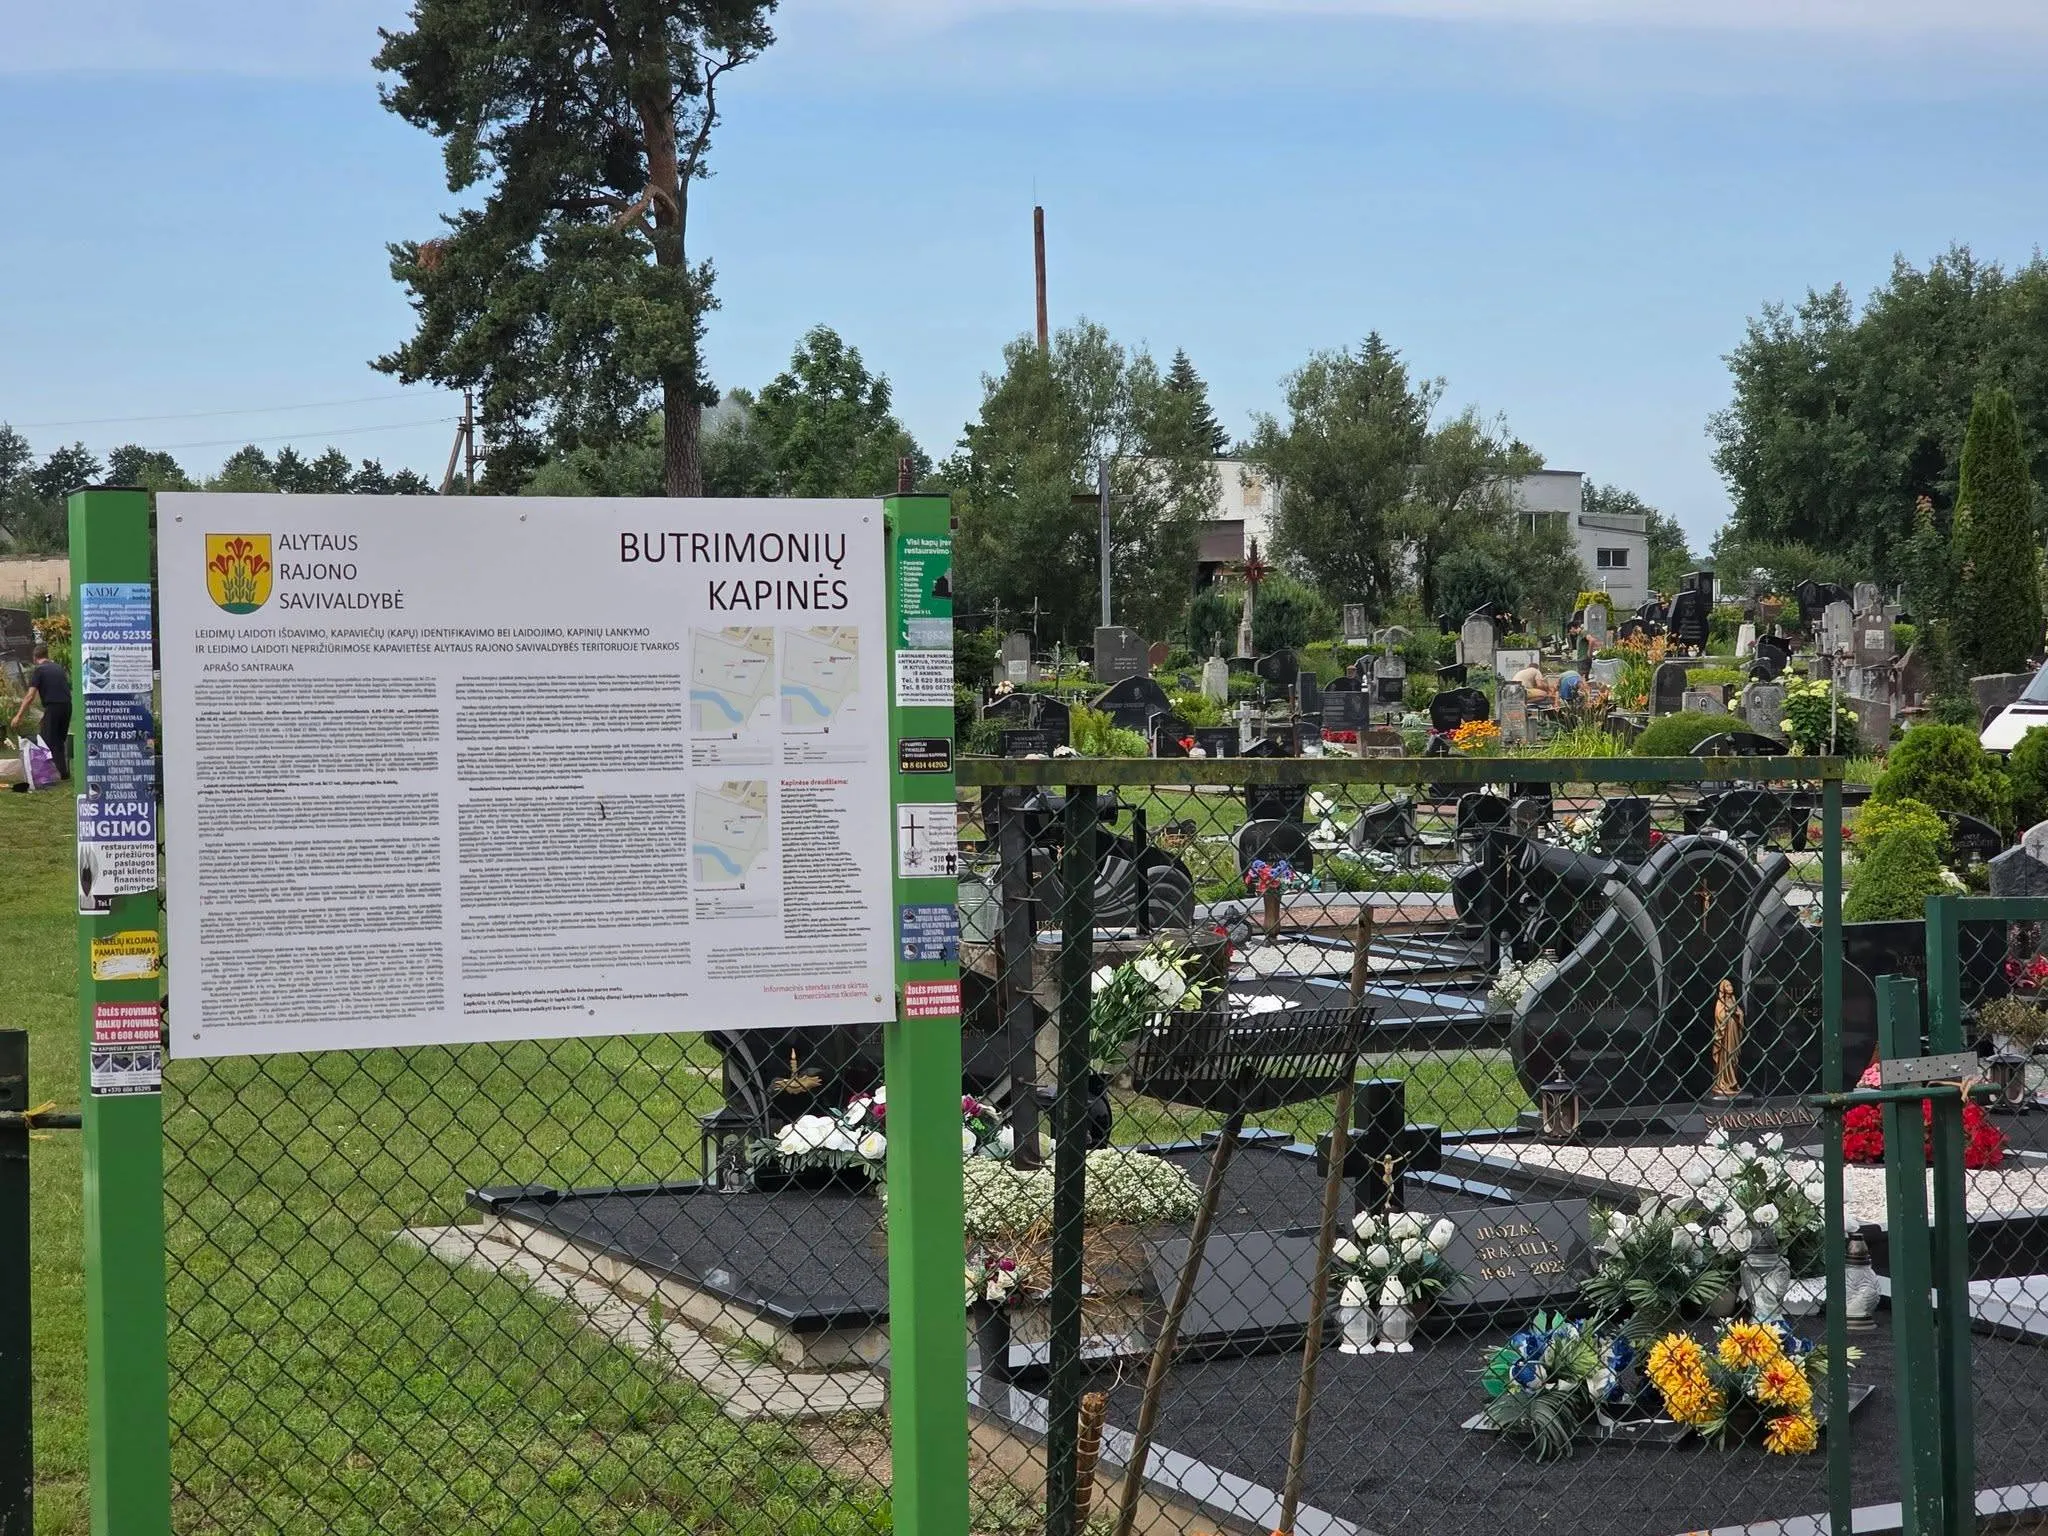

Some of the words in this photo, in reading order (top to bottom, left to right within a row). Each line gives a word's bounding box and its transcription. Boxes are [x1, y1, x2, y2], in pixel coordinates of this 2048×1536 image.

[278, 534, 358, 551] ALYTAUS
[620, 533, 846, 570] BUTRIMONIŲ
[280, 563, 358, 581] RAJONO
[709, 574, 848, 610] KAPINĖS
[279, 589, 404, 610] SAVIVALDYBĖ
[102, 631, 120, 639] 606
[123, 631, 152, 639] 52335
[195, 630, 234, 640] LEIDIMŲ
[238, 630, 275, 638] LAIDOTI
[279, 627, 328, 639] IŠDAVIMO,
[331, 627, 384, 639] KAPAVIEČIŲ
[421, 629, 494, 637] IDENTIFIKAVIMO
[497, 629, 511, 637] BEI
[567, 628, 602, 638] KAPINIŲ
[606, 628, 650, 636] LANKYMO
[195, 645, 204, 653] IR
[208, 645, 248, 653] LEIDIMO
[251, 645, 288, 653] LAIDOTI
[292, 642, 370, 653] NEPRIŽIŪRIMOSE
[434, 644, 473, 652] ALYTAUS
[476, 644, 513, 652] RAJONO
[516, 642, 579, 652] SAVIVALDYBĖS
[582, 643, 638, 651] TERITORIJOJE
[641, 642, 679, 651] TVARKOS
[203, 662, 239, 672] APRAŠO
[104, 731, 119, 739] 671
[104, 802, 148, 818] KAPŲ
[927, 985, 957, 993] PJOVIMAS
[98, 1006, 119, 1016] ŽOLĖS
[121, 1007, 157, 1016] PJOVIMAS
[122, 1019, 159, 1028] PJOVIMAS
[1476, 1224, 1540, 1240] JUOZAS
[1476, 1240, 1558, 1261] GRAULIS
